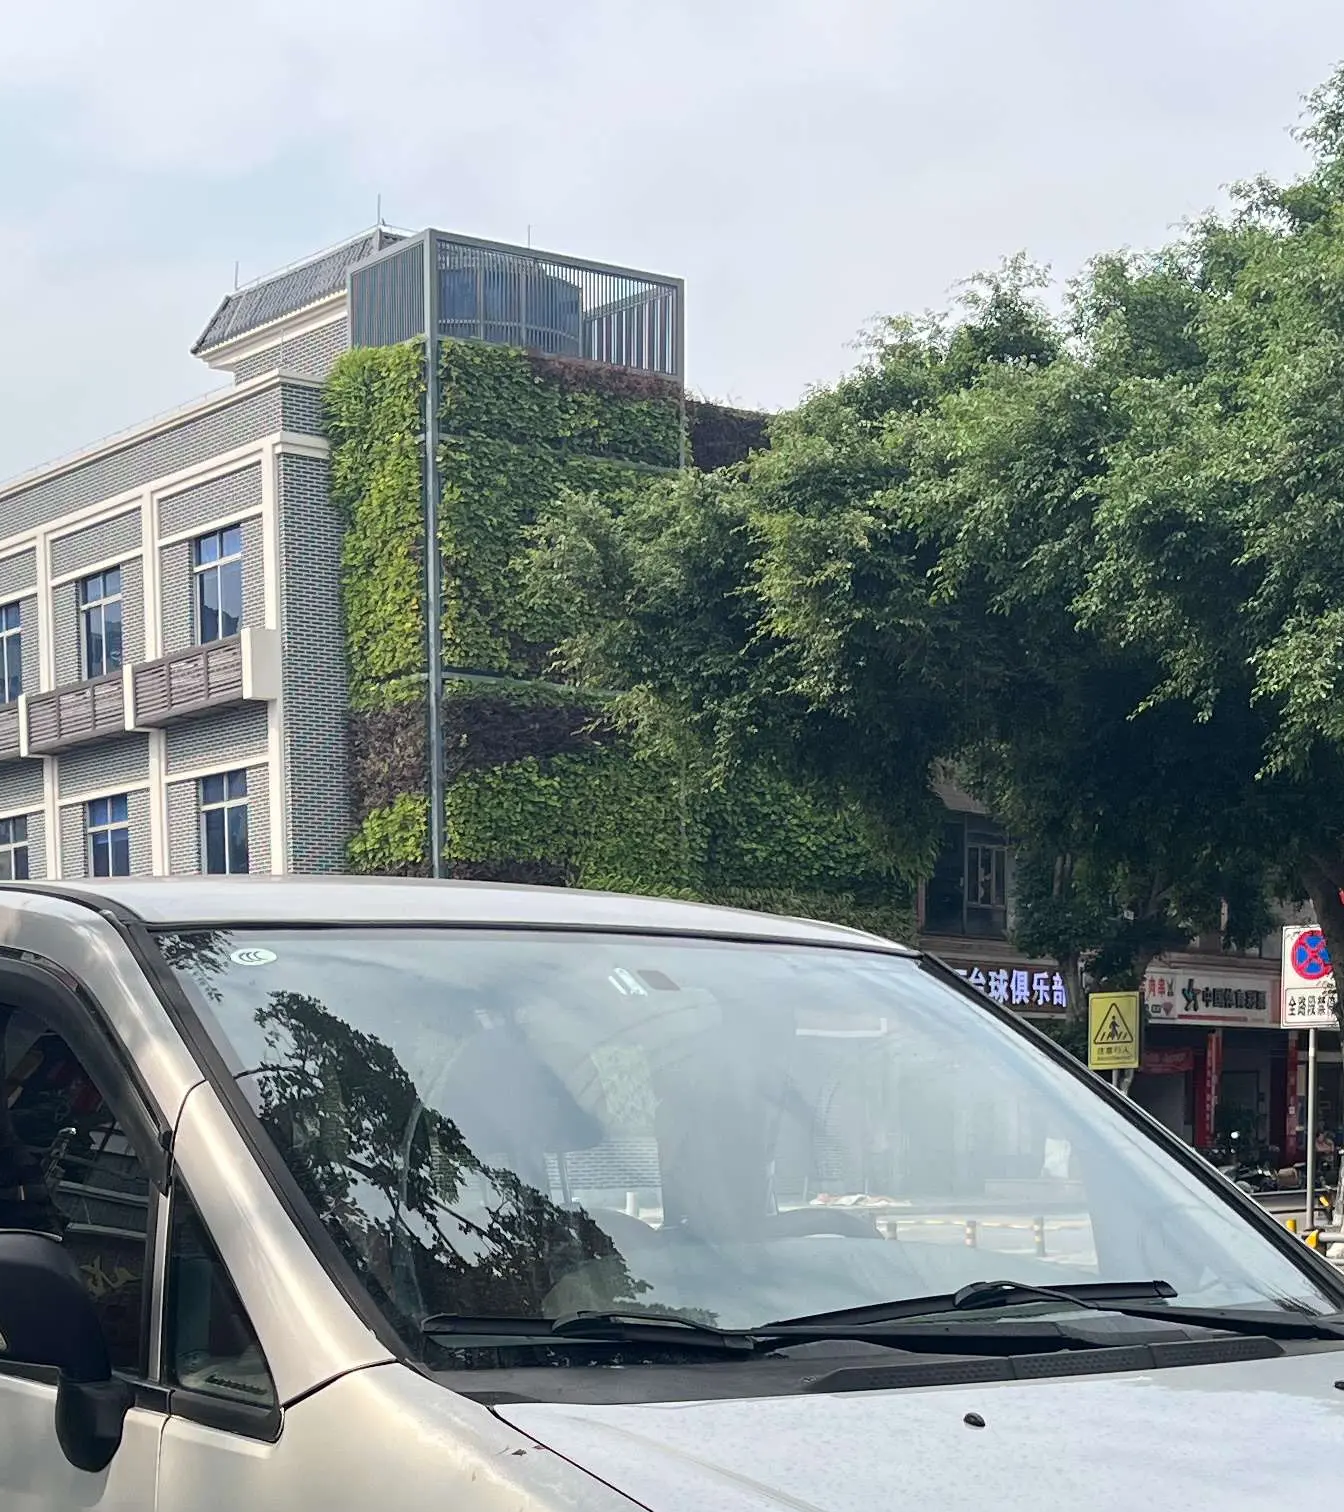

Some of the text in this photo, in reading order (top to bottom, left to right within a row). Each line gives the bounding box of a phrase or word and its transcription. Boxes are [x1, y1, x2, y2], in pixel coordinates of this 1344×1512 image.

[955, 967, 1067, 1007] 台球俱乐部
